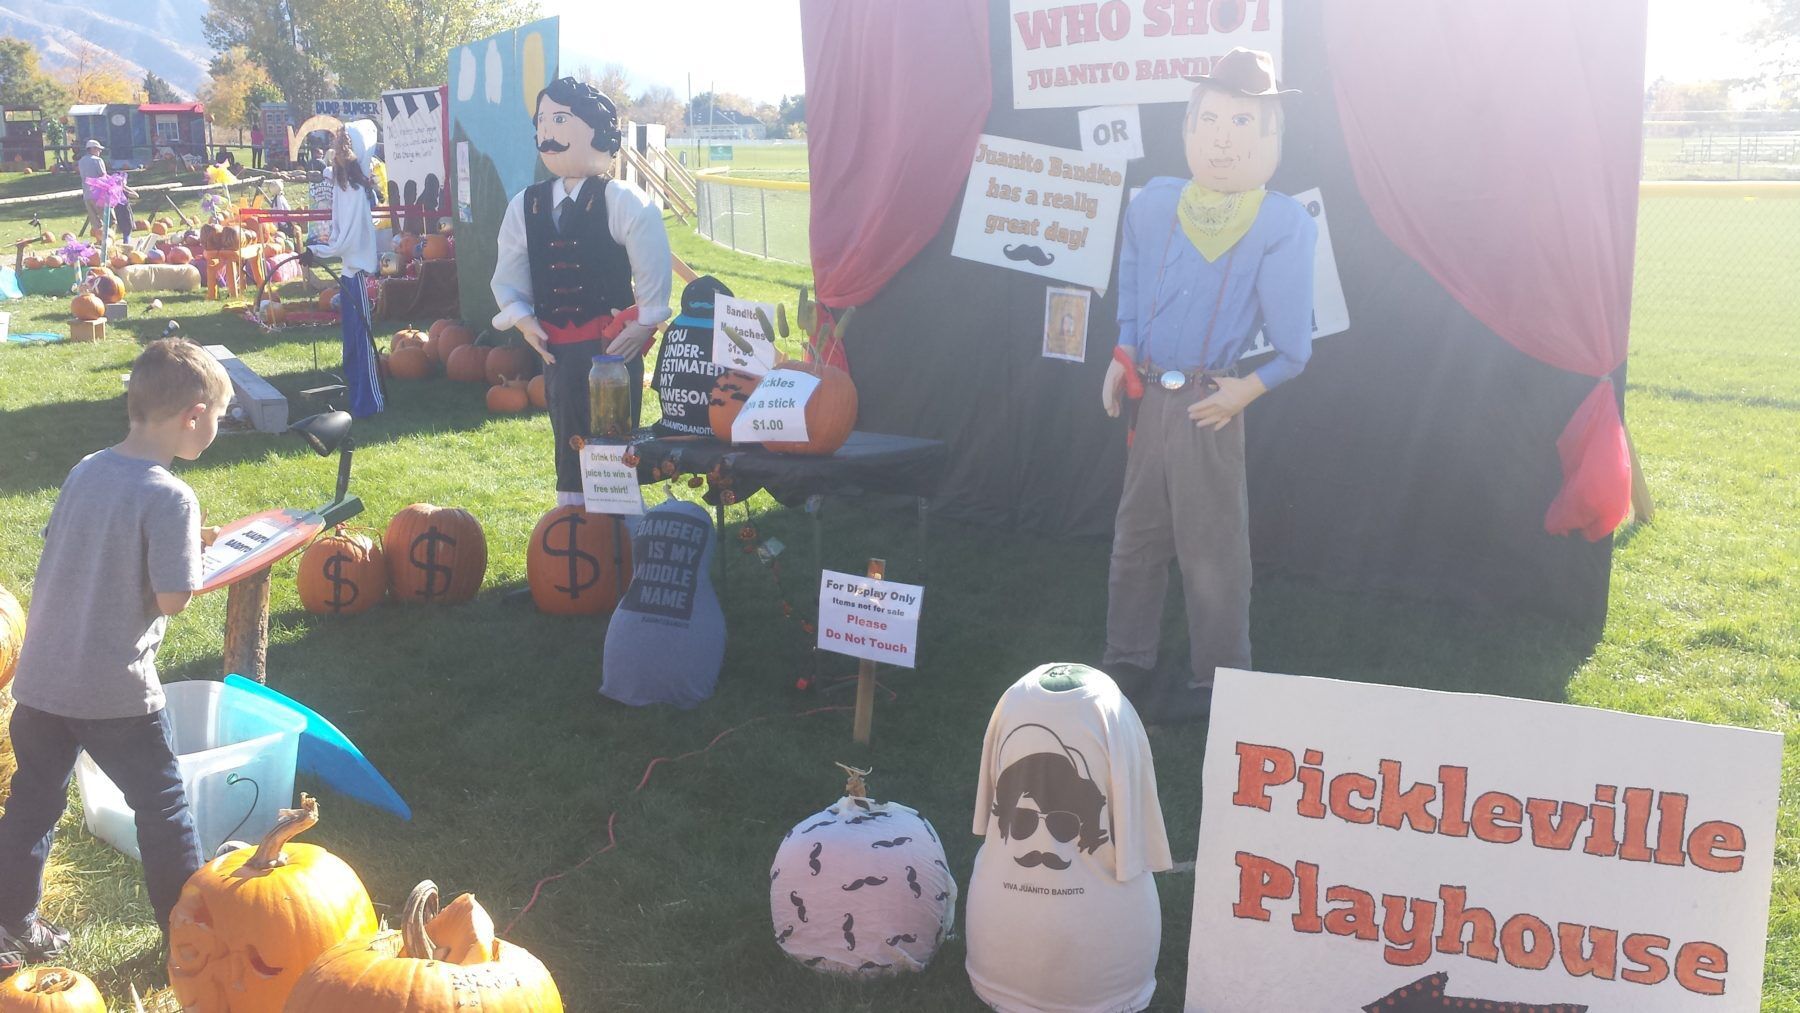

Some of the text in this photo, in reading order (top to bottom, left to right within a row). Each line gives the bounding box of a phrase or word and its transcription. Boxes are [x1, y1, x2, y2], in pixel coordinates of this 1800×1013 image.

[1014, 0, 1270, 50] WHO SHOT
[1027, 61, 1130, 90] JUANITO
[1093, 119, 1129, 146] OR
[975, 143, 1122, 186] Juanito Bandito
[985, 177, 1098, 219] has a really
[984, 214, 1089, 250] great day!
[667, 329, 688, 343] YOU
[720, 321, 766, 341] Mtaches
[664, 343, 704, 359] UNDER-
[660, 373, 675, 387] MY
[760, 377, 796, 388] ickles
[758, 400, 765, 409] a
[768, 397, 796, 409] stick
[753, 419, 783, 431] $1.00
[604, 470, 611, 478] to
[612, 470, 626, 478] win
[594, 484, 609, 493] free
[637, 519, 704, 545] DANGER
[648, 541, 698, 565] IS MY
[635, 562, 693, 588] MIDDLE
[640, 585, 688, 610] NAME
[826, 579, 916, 605] For Display Only
[832, 597, 904, 617] Items not for sale
[846, 614, 888, 631] Please
[826, 628, 907, 654] Do Not Touch
[1232, 741, 1746, 873] Pickleville
[1003, 881, 1085, 896] VIVA JUANITO BANDITO
[1232, 851, 1729, 995] Playhouse
